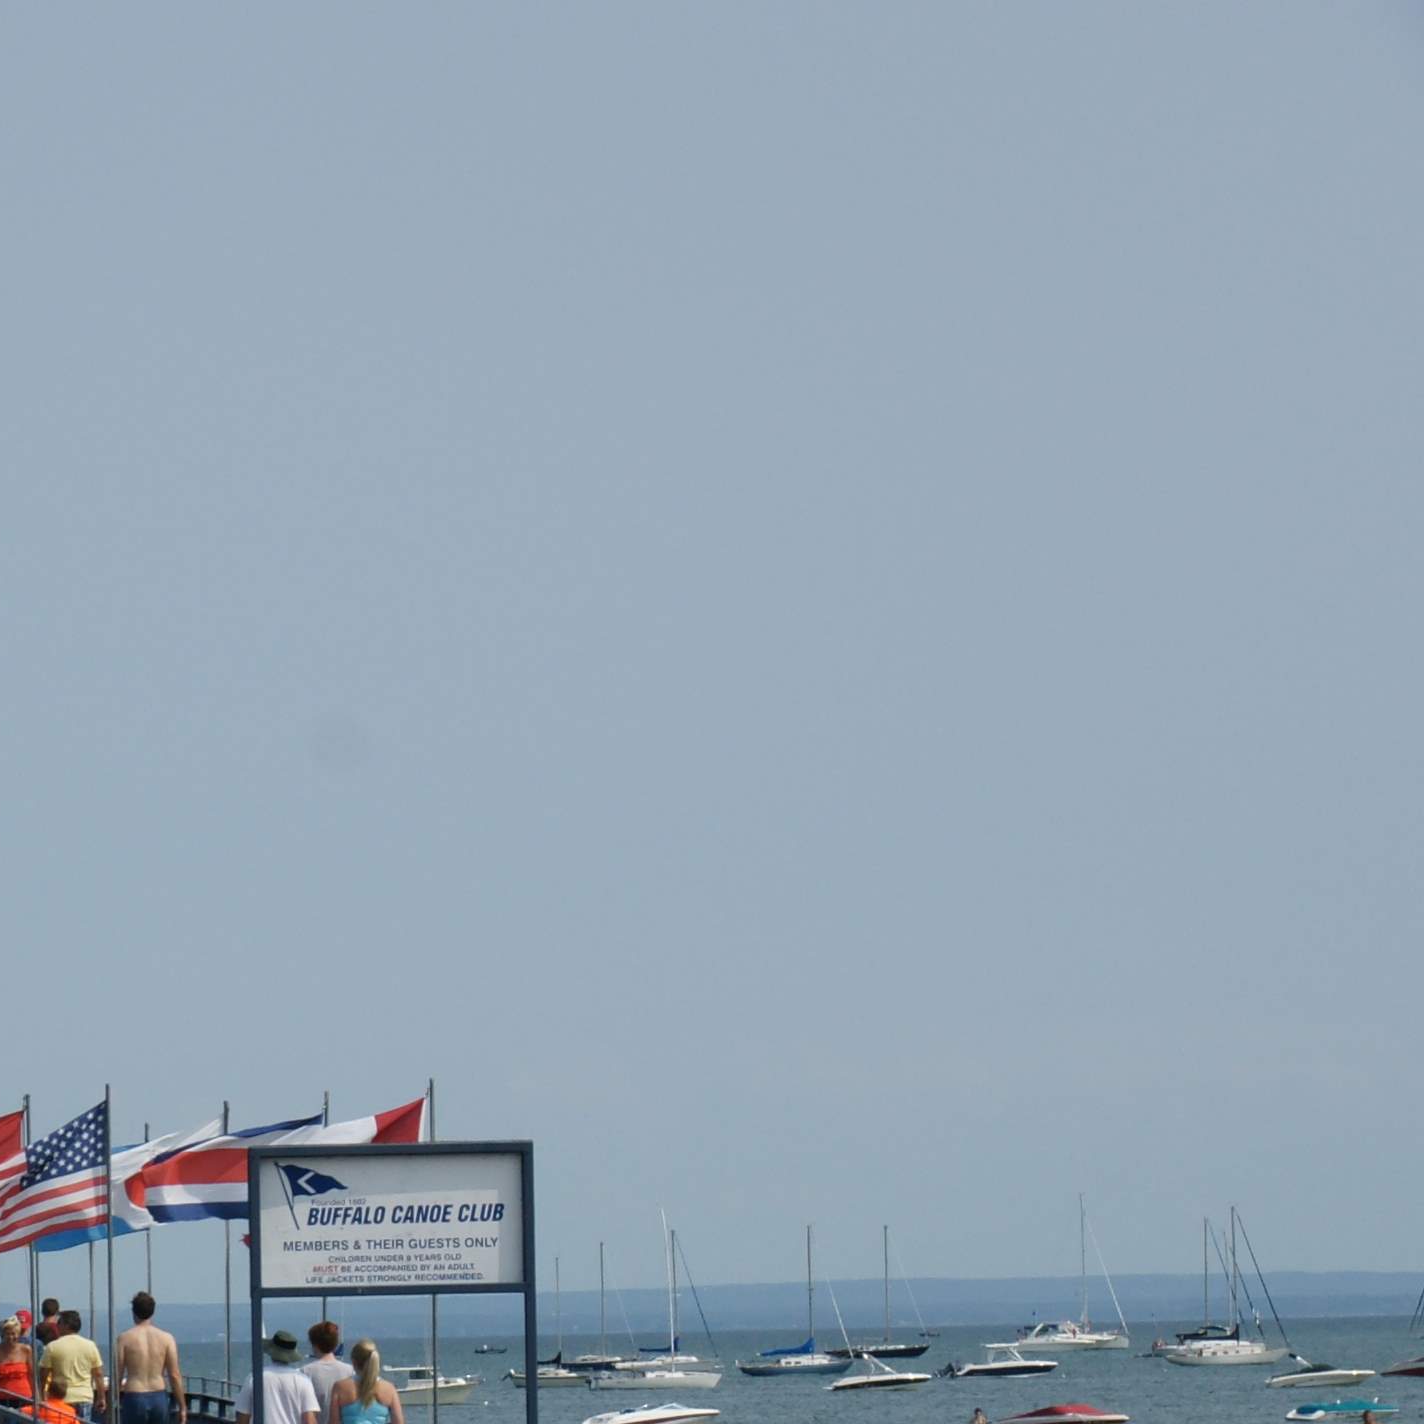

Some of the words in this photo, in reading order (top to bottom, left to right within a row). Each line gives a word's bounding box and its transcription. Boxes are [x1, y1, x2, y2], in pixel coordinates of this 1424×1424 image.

[306, 1205, 387, 1227] BUFFALO
[390, 1204, 454, 1225] CANOE
[457, 1202, 505, 1223] CLUB
[282, 1240, 350, 1252] MEMBERS
[353, 1240, 361, 1250] &
[365, 1239, 405, 1250] THEIR
[408, 1238, 461, 1249] GUESTS
[464, 1236, 499, 1248] ONLY
[328, 1255, 372, 1264] CHILDREN
[374, 1254, 404, 1263] UNDER
[414, 1253, 442, 1262] YEARS
[444, 1252, 462, 1261] OLD
[312, 1265, 339, 1273] MUST
[341, 1265, 352, 1273] BE
[354, 1264, 418, 1273] ACCOMPANIED
[420, 1264, 431, 1272] BY
[433, 1263, 445, 1271] AN
[305, 1276, 324, 1284] LIFE
[326, 1275, 364, 1284] JACKETS
[367, 1274, 412, 1282] STRONGLY
